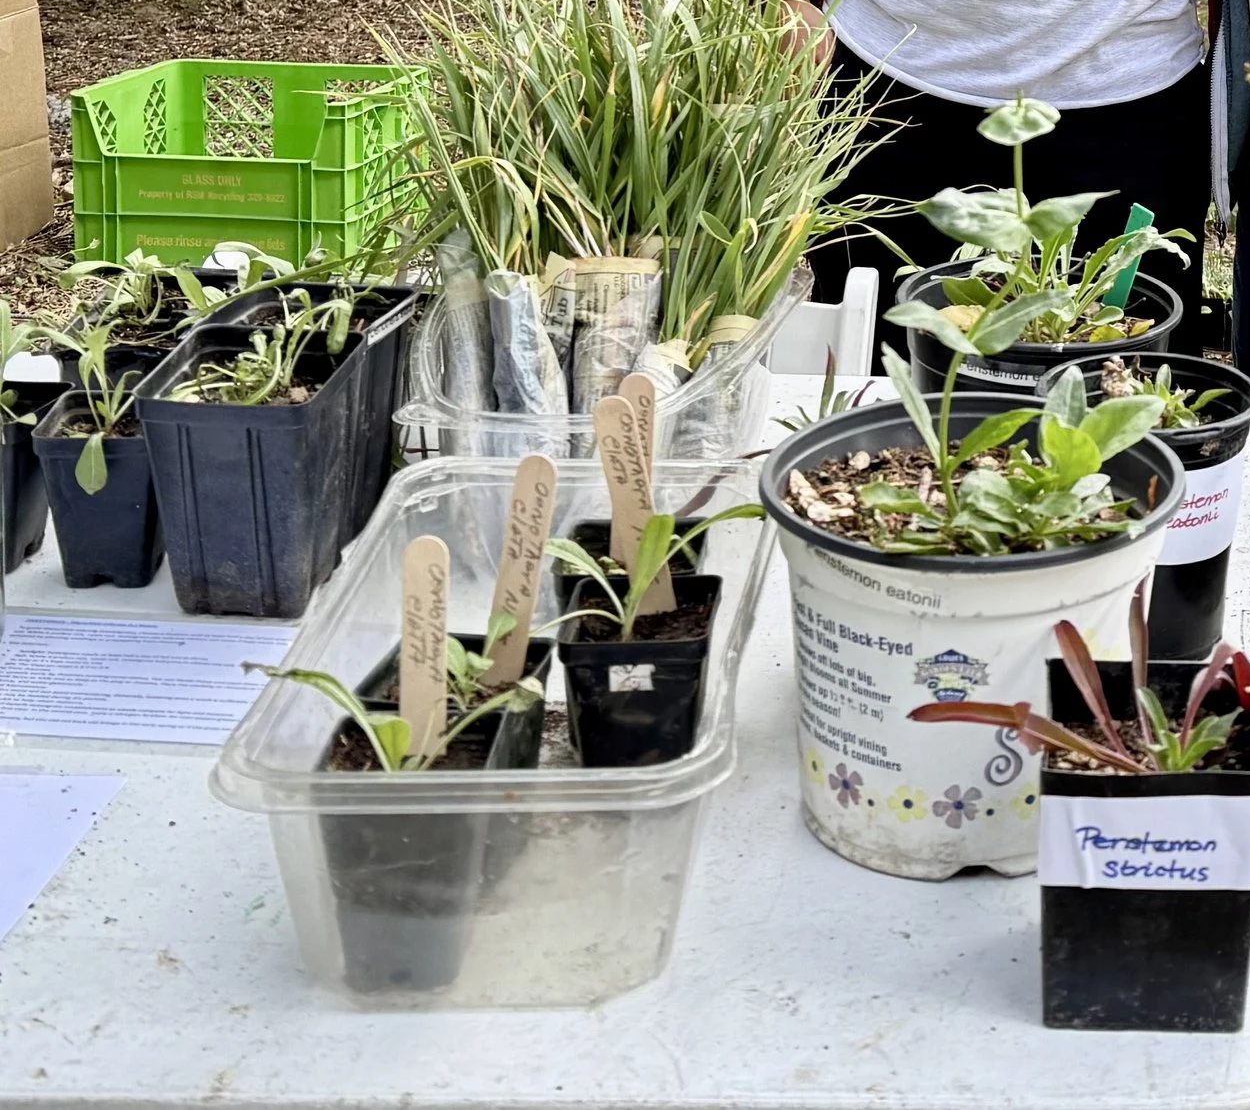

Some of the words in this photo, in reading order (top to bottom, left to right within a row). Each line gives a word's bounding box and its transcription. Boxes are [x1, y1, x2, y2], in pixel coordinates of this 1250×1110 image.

[182, 174, 215, 186] GLASS
[217, 175, 242, 187] ONLY
[136, 234, 174, 246] Please
[963, 360, 1028, 381] enstemon
[1178, 487, 1229, 511] stemon
[886, 585, 942, 609] eatonii
[816, 613, 836, 635] Full
[839, 622, 913, 656] Black-Eyed
[816, 629, 839, 653] Vine
[851, 681, 892, 704] Summer
[858, 733, 887, 757] vining
[851, 748, 902, 772] containers
[1075, 826, 1217, 853] Penstemon
